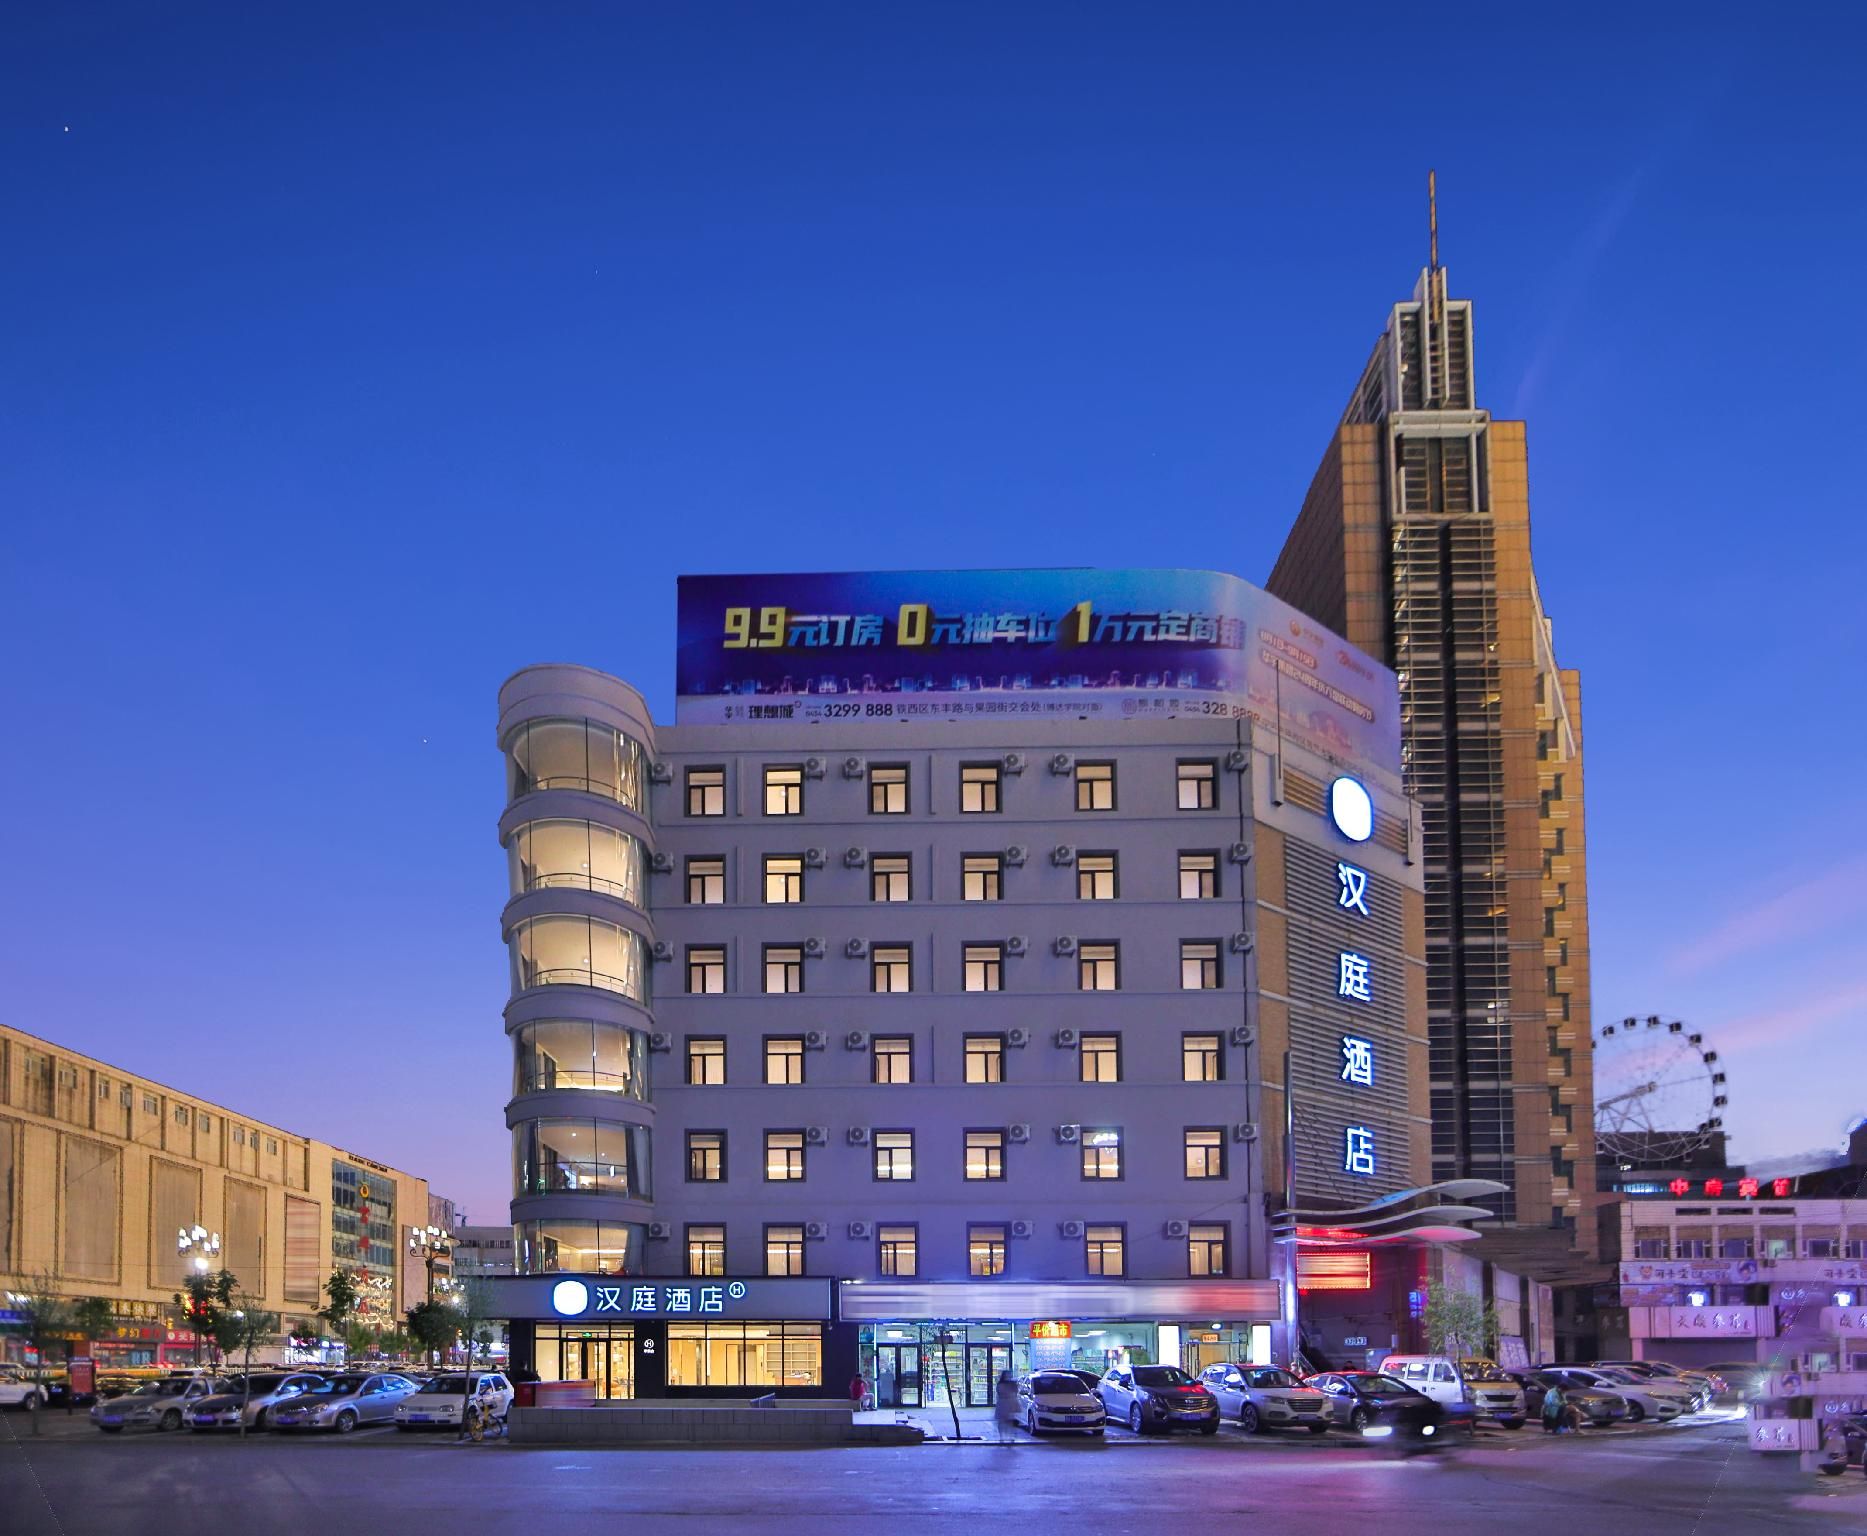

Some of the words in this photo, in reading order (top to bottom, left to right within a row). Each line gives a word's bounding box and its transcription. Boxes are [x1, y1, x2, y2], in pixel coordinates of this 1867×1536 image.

[723, 606, 884, 648] 9.9元订房
[897, 604, 1057, 646] 0元抽车位
[824, 703, 861, 717] 3299
[866, 703, 893, 716] 888
[1202, 701, 1228, 716] 328
[1338, 863, 1374, 1174] 汉庭酒店
[596, 1286, 723, 1312] 汉庭酒店
